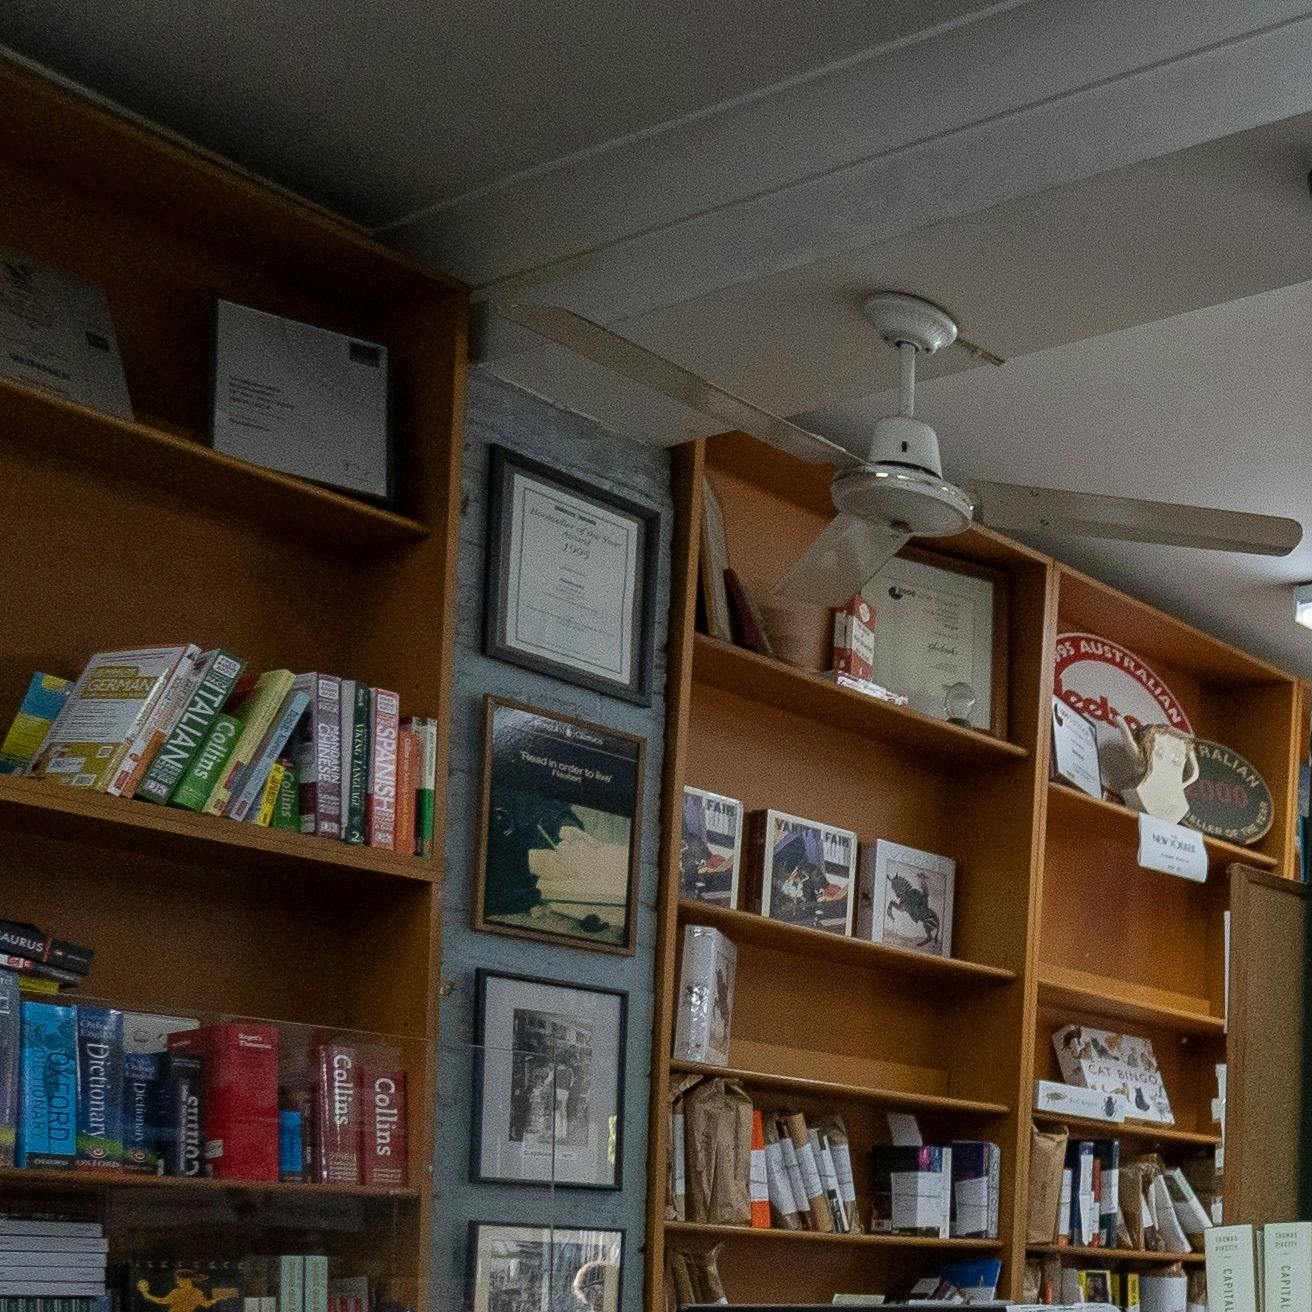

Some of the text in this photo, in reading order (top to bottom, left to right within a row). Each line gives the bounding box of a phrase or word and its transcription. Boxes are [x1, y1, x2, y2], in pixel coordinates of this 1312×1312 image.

[1079, 638, 1183, 726] AUSTRALIAN
[162, 682, 228, 770] ITALIAN
[195, 719, 236, 781] Collins
[317, 722, 329, 783] CHINESE
[281, 770, 298, 819] Collins
[374, 724, 398, 813] SPANISH
[350, 830, 361, 842] 2
[824, 832, 850, 849] FAIR
[49, 1049, 71, 1143] OXFORD
[86, 1042, 110, 1140] Dictionary
[333, 1053, 354, 1126] Collins
[1088, 1063, 1158, 1084] CAT BINGO
[132, 1082, 147, 1143] Dictionary
[185, 1095, 200, 1176] Collins
[374, 1076, 399, 1157] Collins
